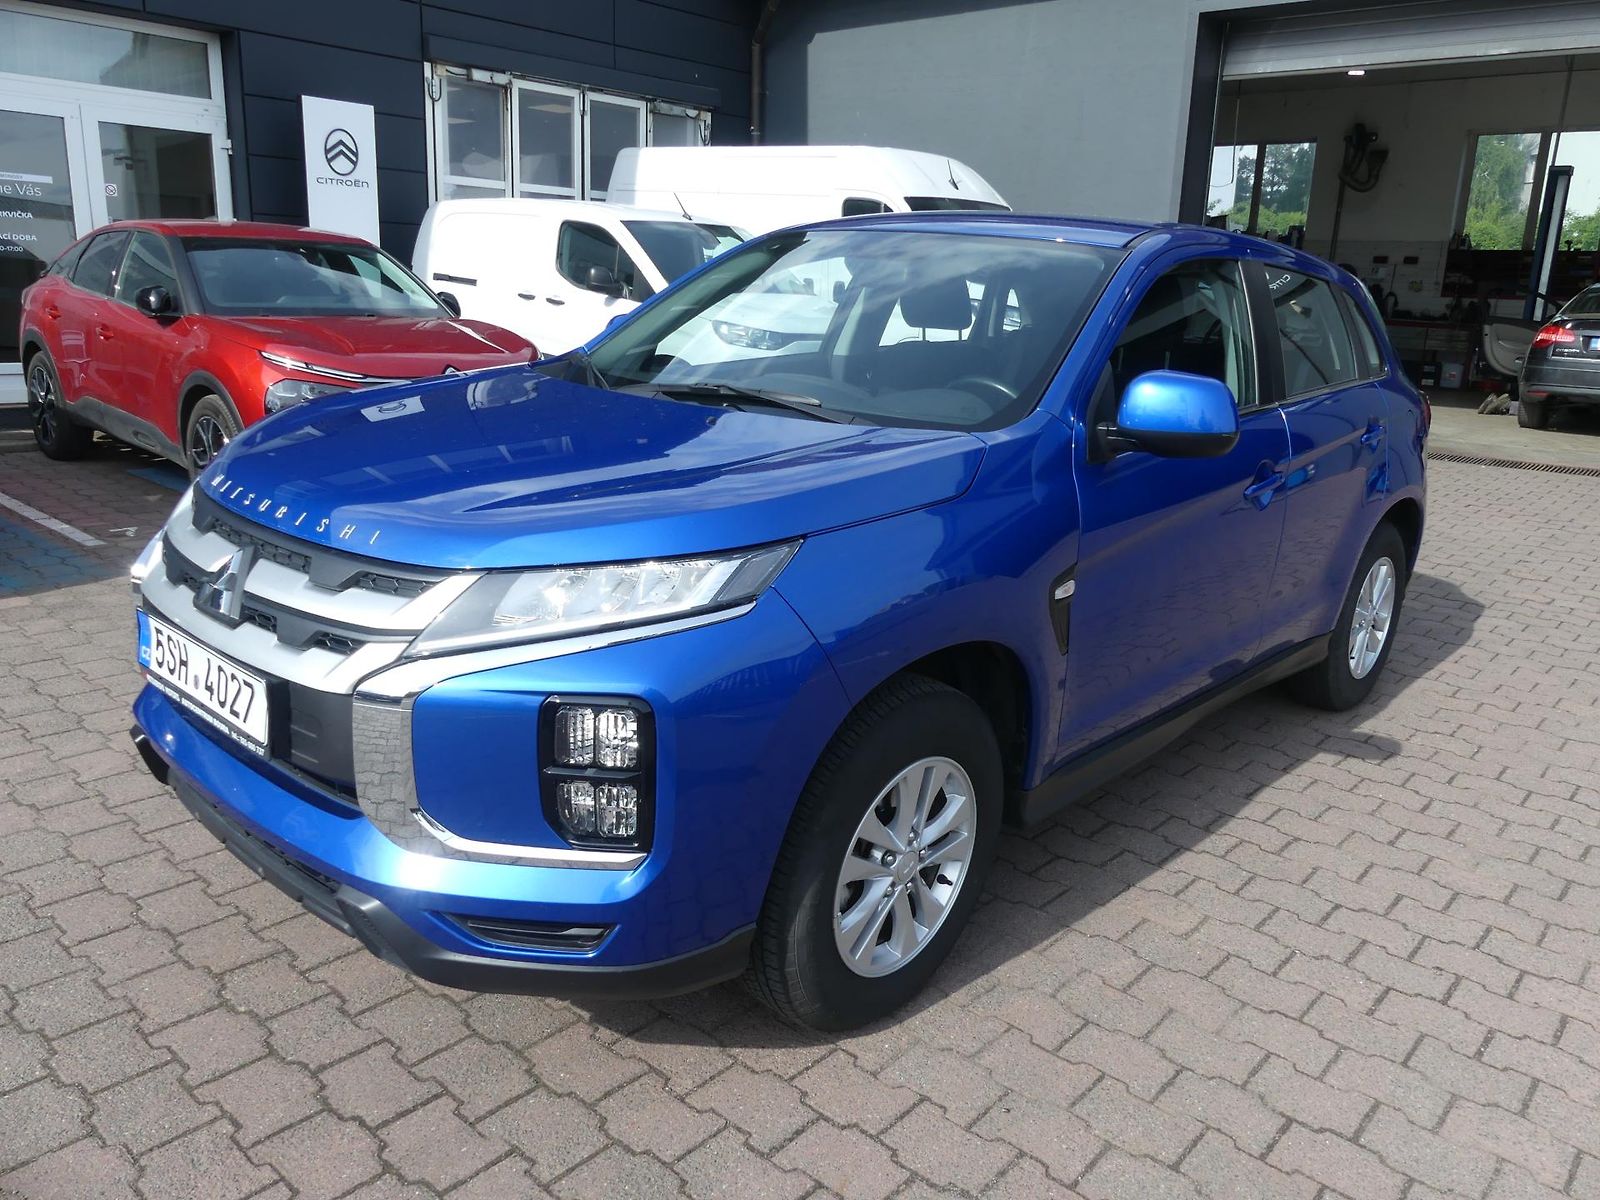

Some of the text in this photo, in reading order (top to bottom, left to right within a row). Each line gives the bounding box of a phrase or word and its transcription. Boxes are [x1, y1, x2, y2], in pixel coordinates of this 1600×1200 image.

[15, 183, 42, 197] Vás
[12, 233, 37, 241] DOBA
[211, 473, 380, 545] MITSUBISHI
[154, 626, 189, 685] 5SH
[204, 657, 255, 723] 4027
